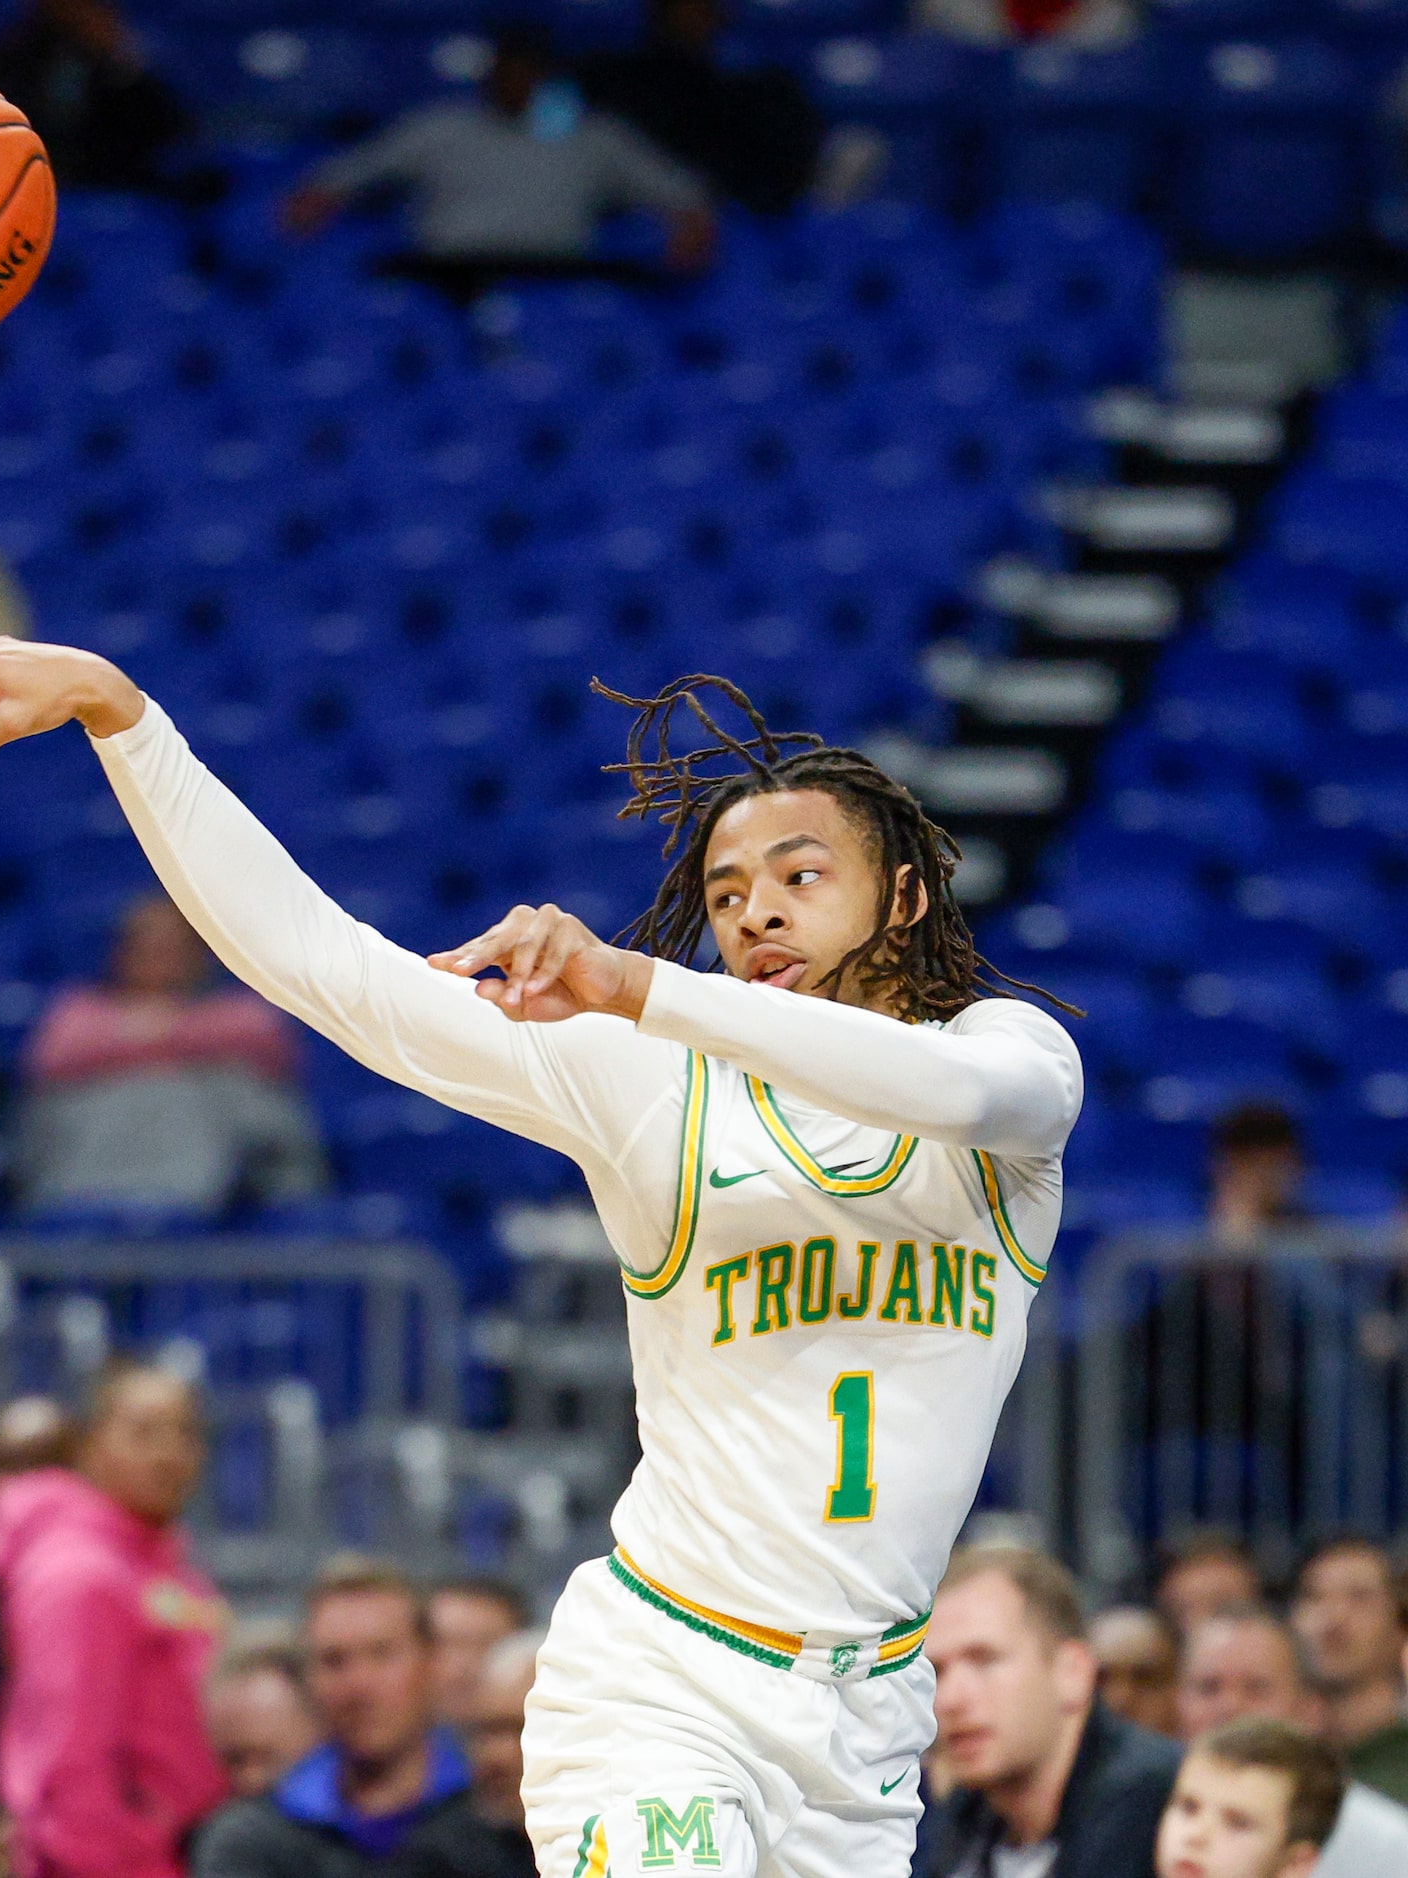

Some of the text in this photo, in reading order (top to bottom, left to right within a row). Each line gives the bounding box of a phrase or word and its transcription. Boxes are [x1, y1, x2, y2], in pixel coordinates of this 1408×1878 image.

[704, 1235, 998, 1348] TROJANS
[822, 1370, 877, 1524] 1
[635, 1795, 723, 1872] M
